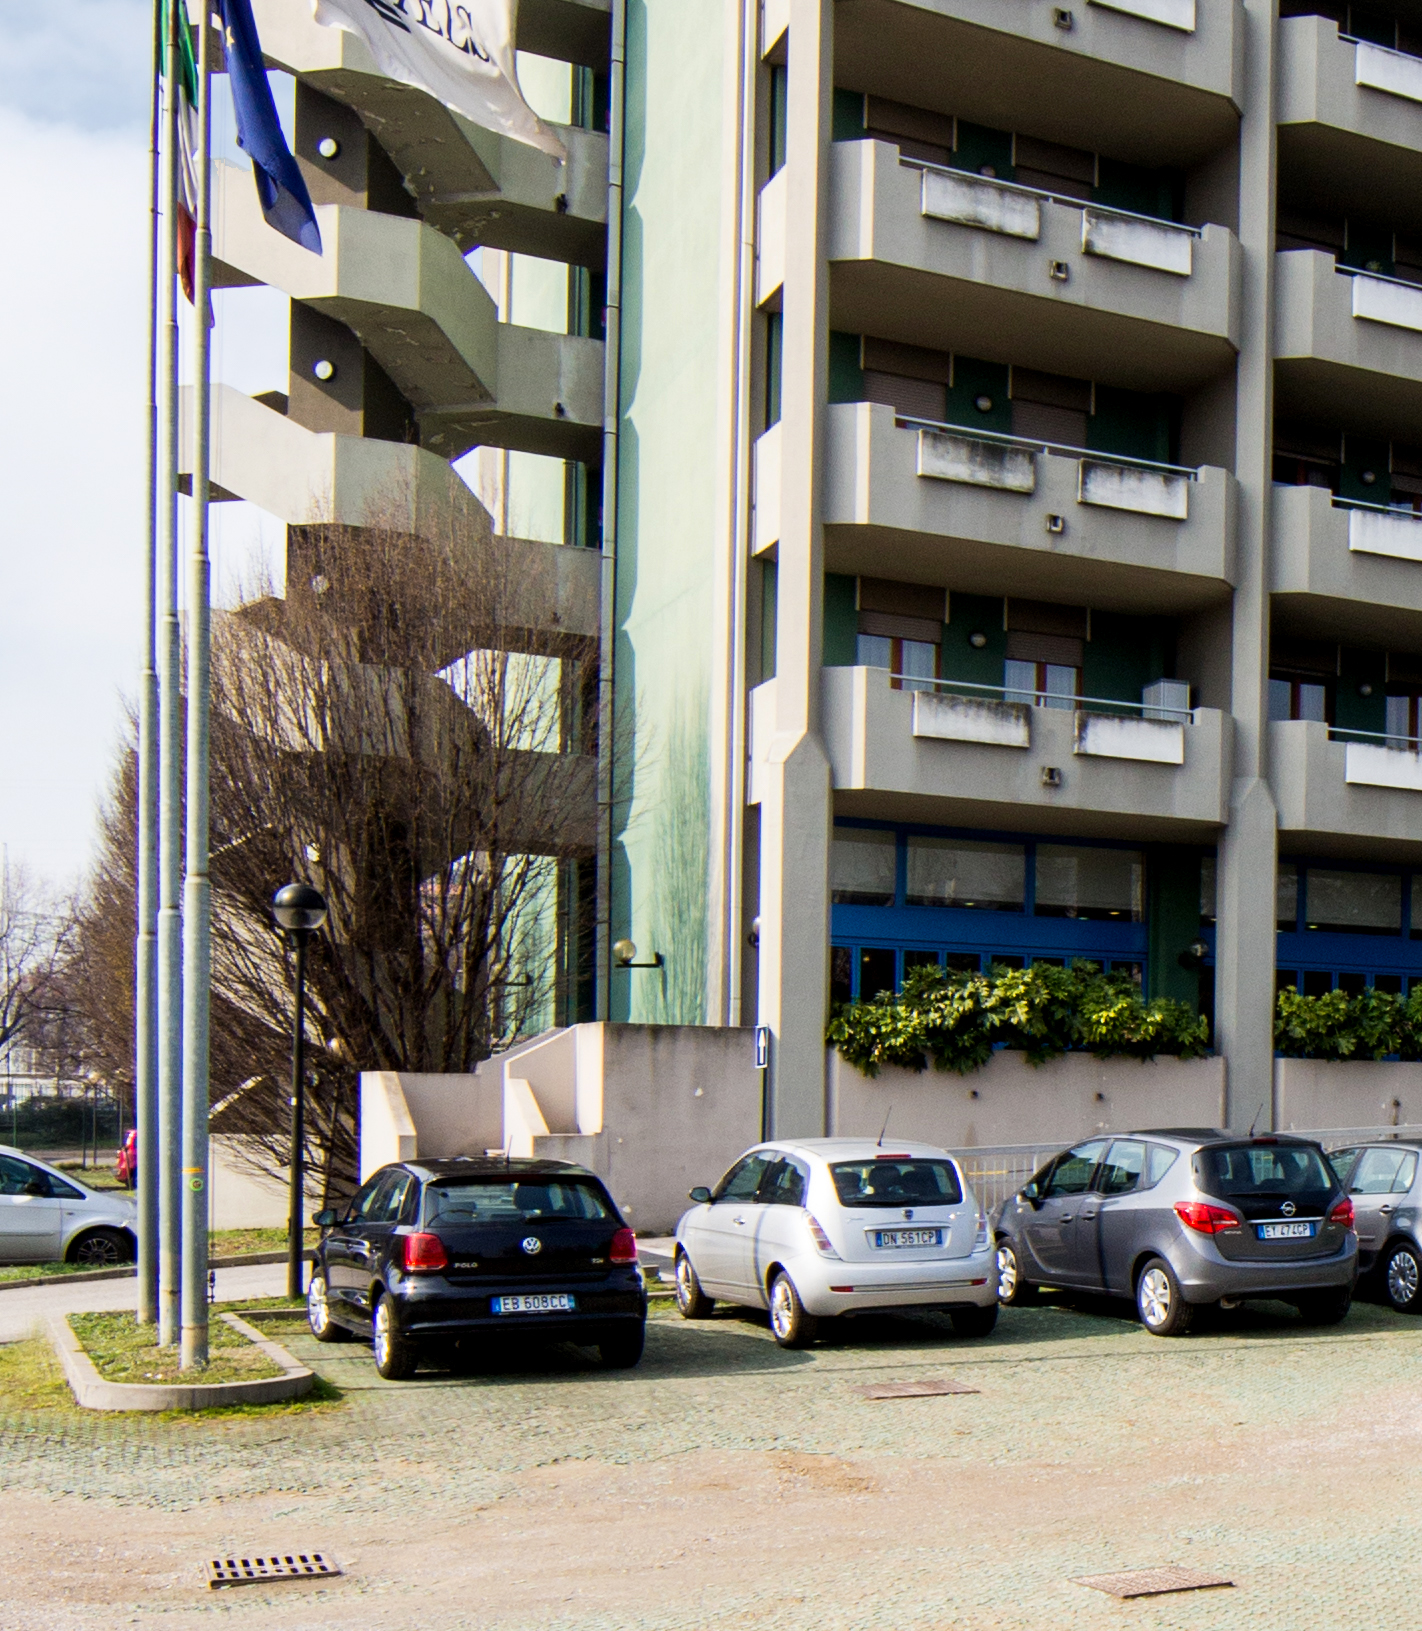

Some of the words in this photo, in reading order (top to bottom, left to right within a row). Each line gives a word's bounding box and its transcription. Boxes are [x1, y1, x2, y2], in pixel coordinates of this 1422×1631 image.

[883, 1232, 897, 1245] DN
[503, 1297, 520, 1311] EB
[524, 1295, 567, 1309] 608CC
